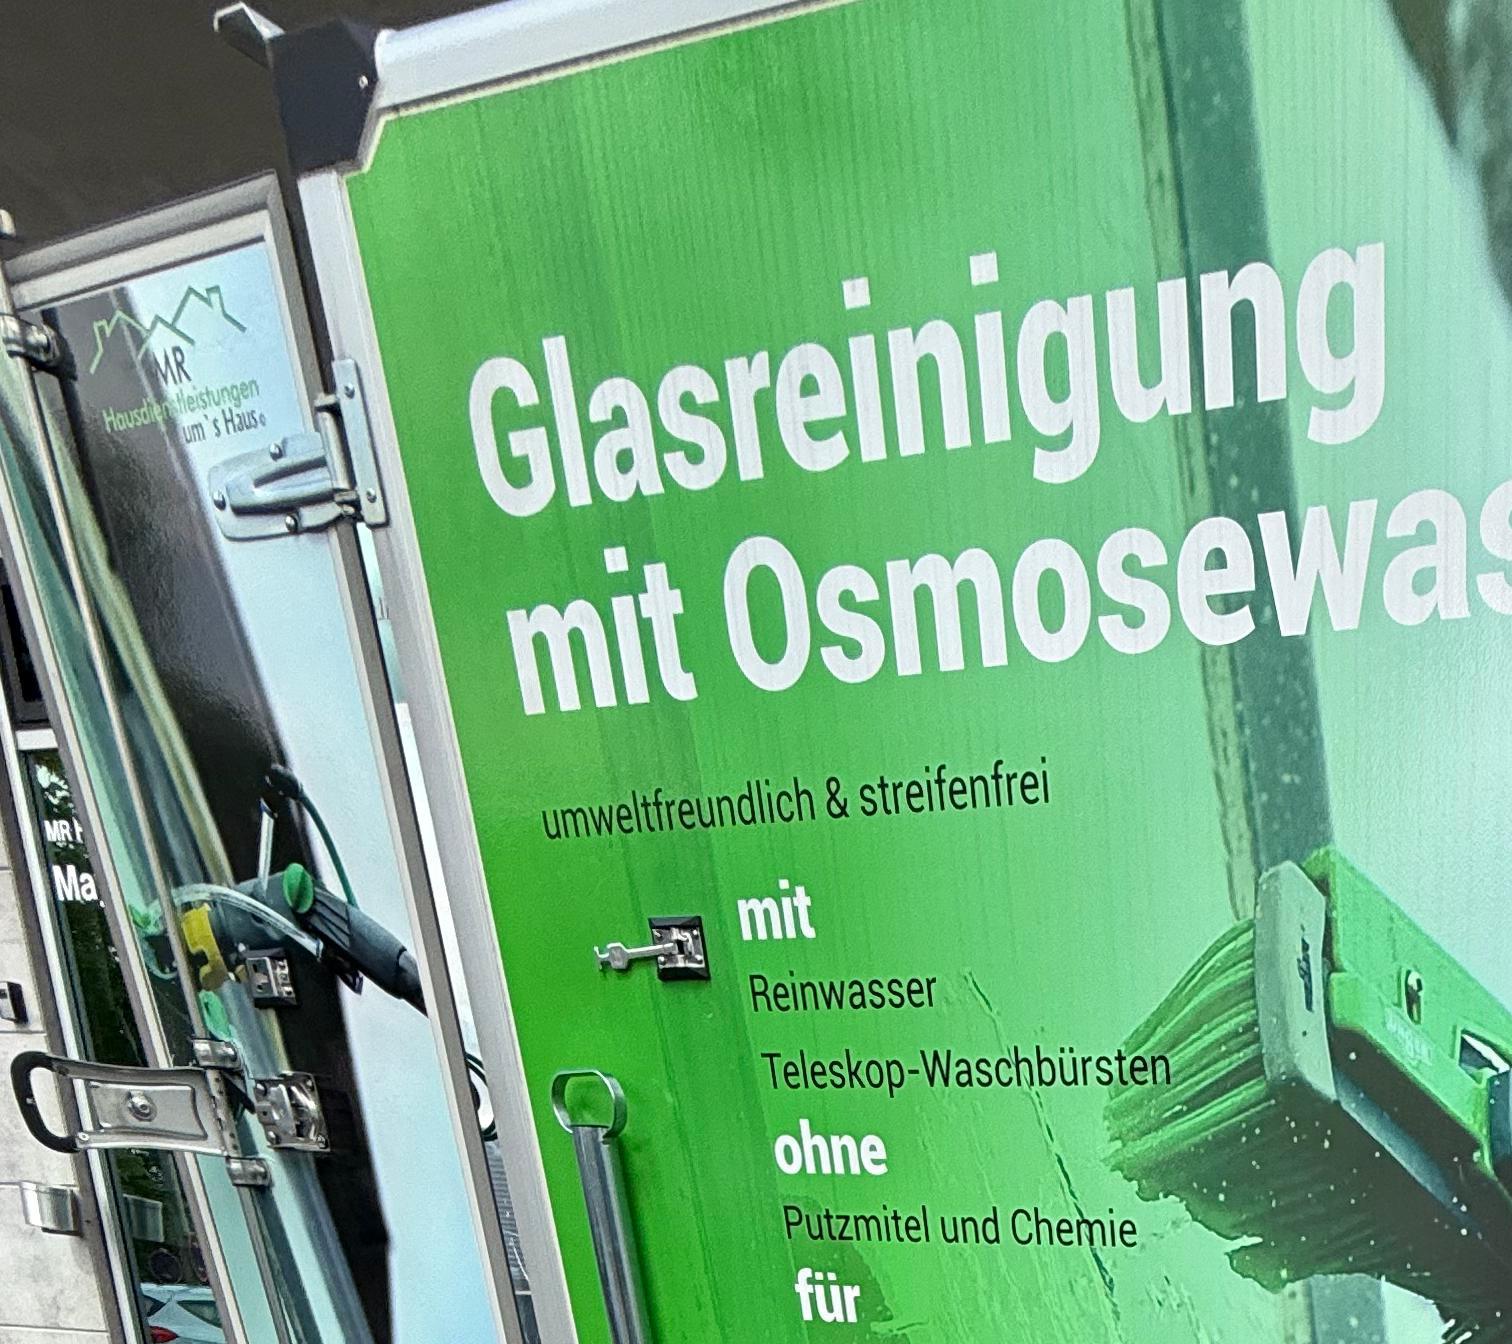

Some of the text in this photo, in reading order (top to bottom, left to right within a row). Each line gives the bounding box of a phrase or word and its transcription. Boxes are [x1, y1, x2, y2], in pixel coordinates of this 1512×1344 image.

[467, 241, 1388, 519] Glasreinigung
[504, 545, 701, 717] mit
[541, 756, 1053, 842] umweltfreundlich & streifenfrei
[43, 819, 73, 842] MR
[736, 880, 817, 941] mit
[749, 971, 938, 1014] Reinwasser
[761, 1046, 1173, 1100] Teleskop-Waschbürsten
[773, 1118, 888, 1177] ohne
[782, 1205, 1138, 1249] Putzmitel und Chemie
[794, 1268, 861, 1325] für
